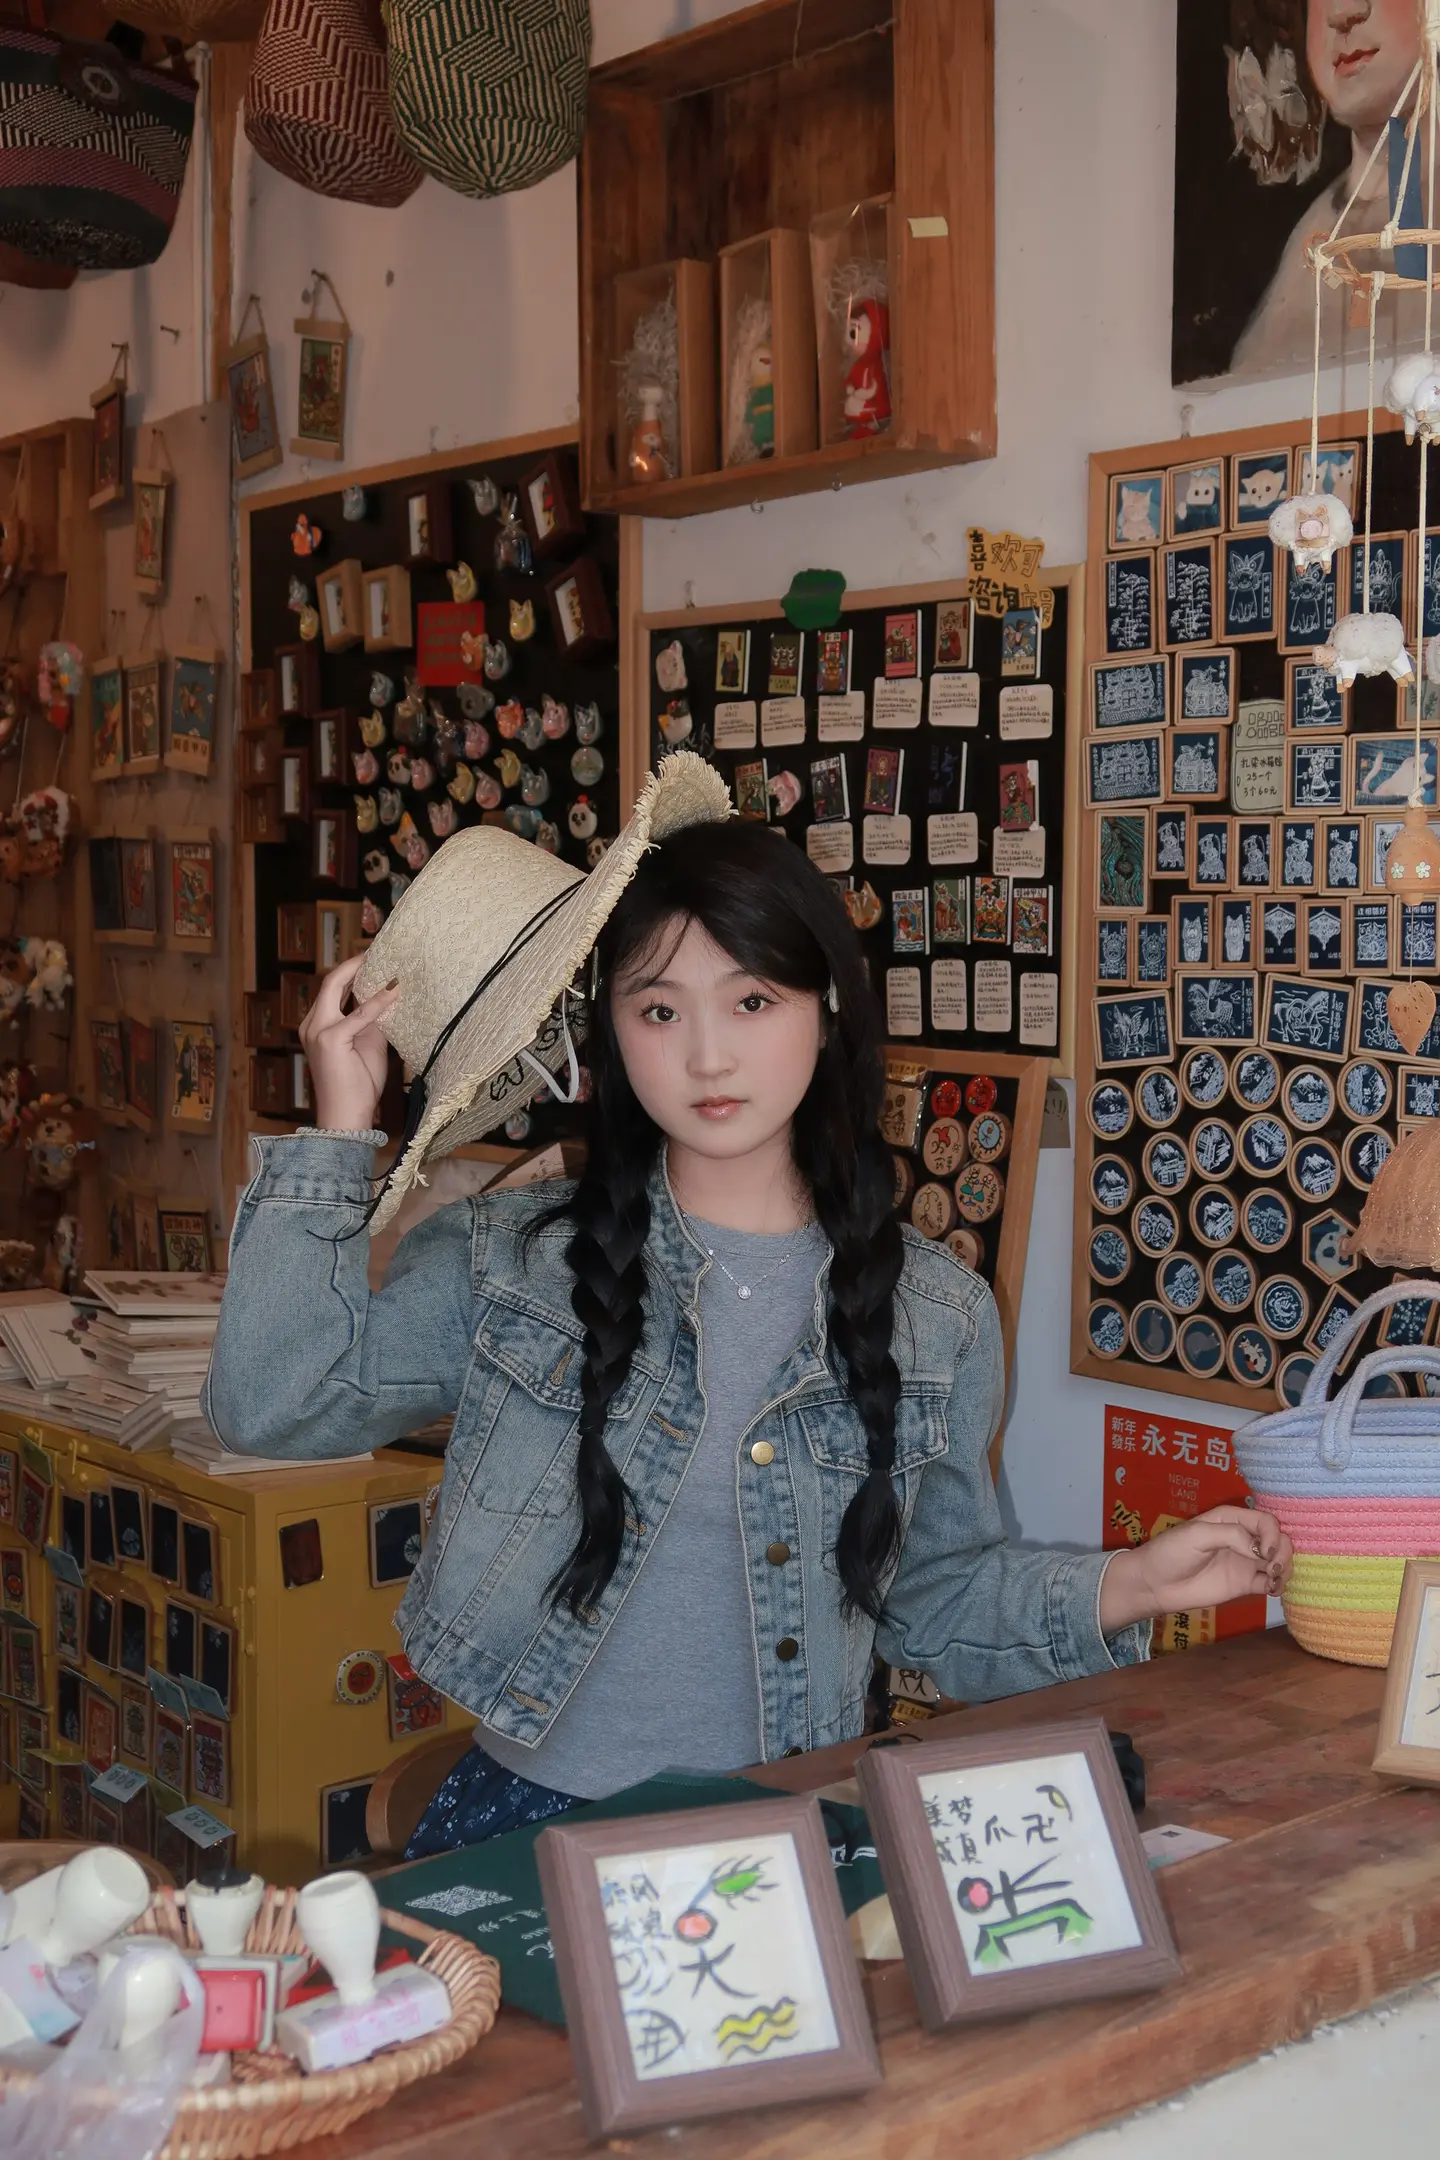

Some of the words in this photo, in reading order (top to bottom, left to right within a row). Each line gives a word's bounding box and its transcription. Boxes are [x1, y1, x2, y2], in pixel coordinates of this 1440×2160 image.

[1246, 771, 1273, 783] 25一个
[1243, 787, 1278, 798] 3个60元
[1112, 1416, 1137, 1434] 新年
[1141, 1423, 1230, 1472] 永无岛
[1169, 1473, 1200, 1489] NEVER
[1171, 1488, 1197, 1501] LAND
